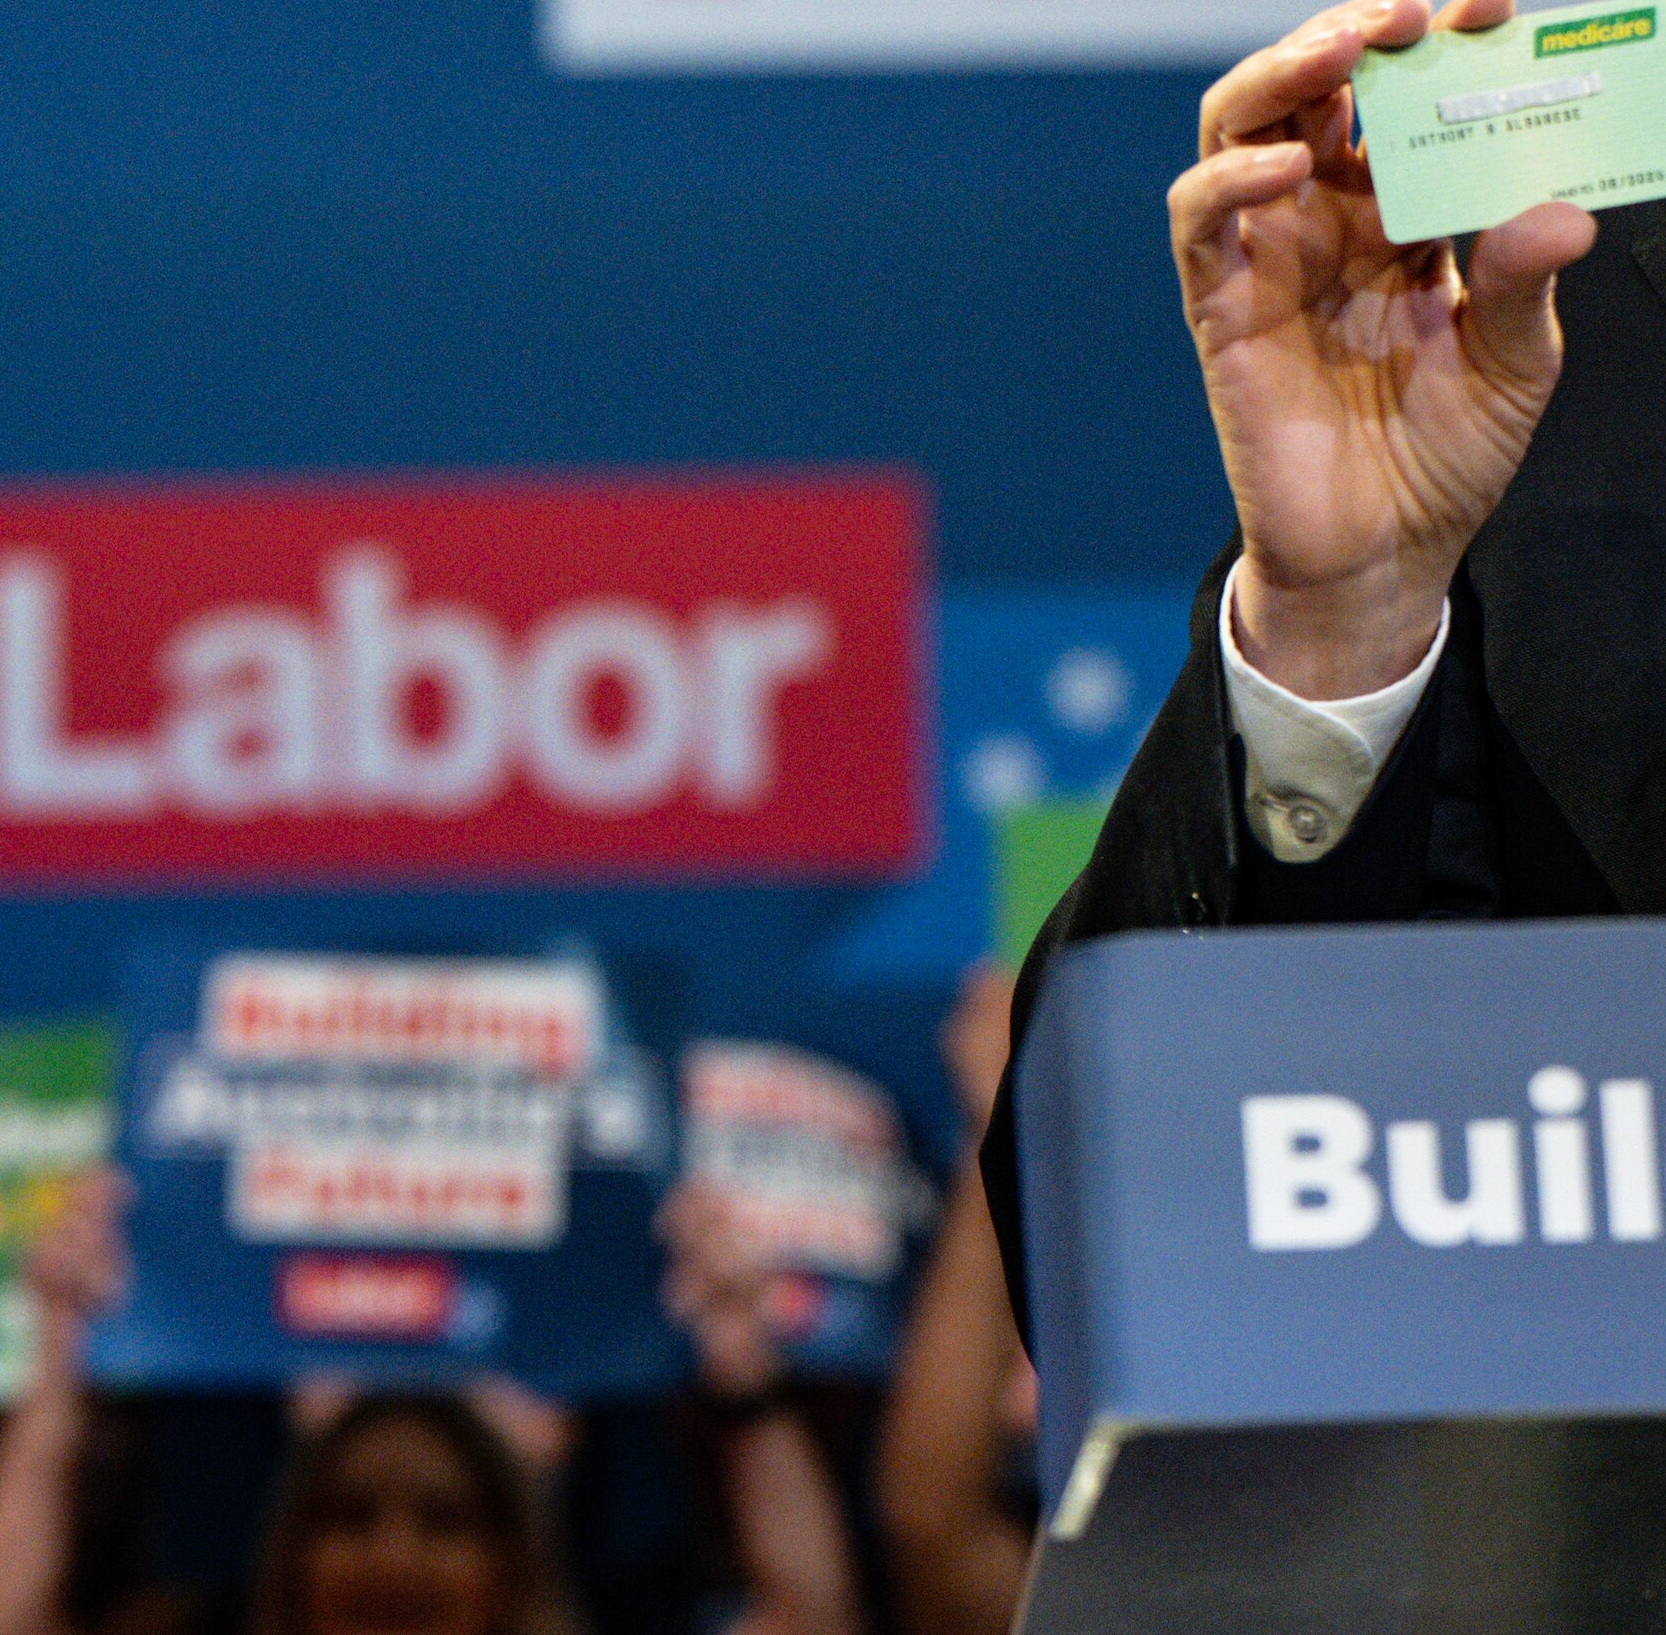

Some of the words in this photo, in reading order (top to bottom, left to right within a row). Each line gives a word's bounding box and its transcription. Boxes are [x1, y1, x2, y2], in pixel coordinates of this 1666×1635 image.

[1541, 16, 1651, 52] medicare
[1408, 126, 1474, 148] ANTHONY
[1505, 108, 1582, 133] ALBANESE
[223, 967, 579, 1077] Building
